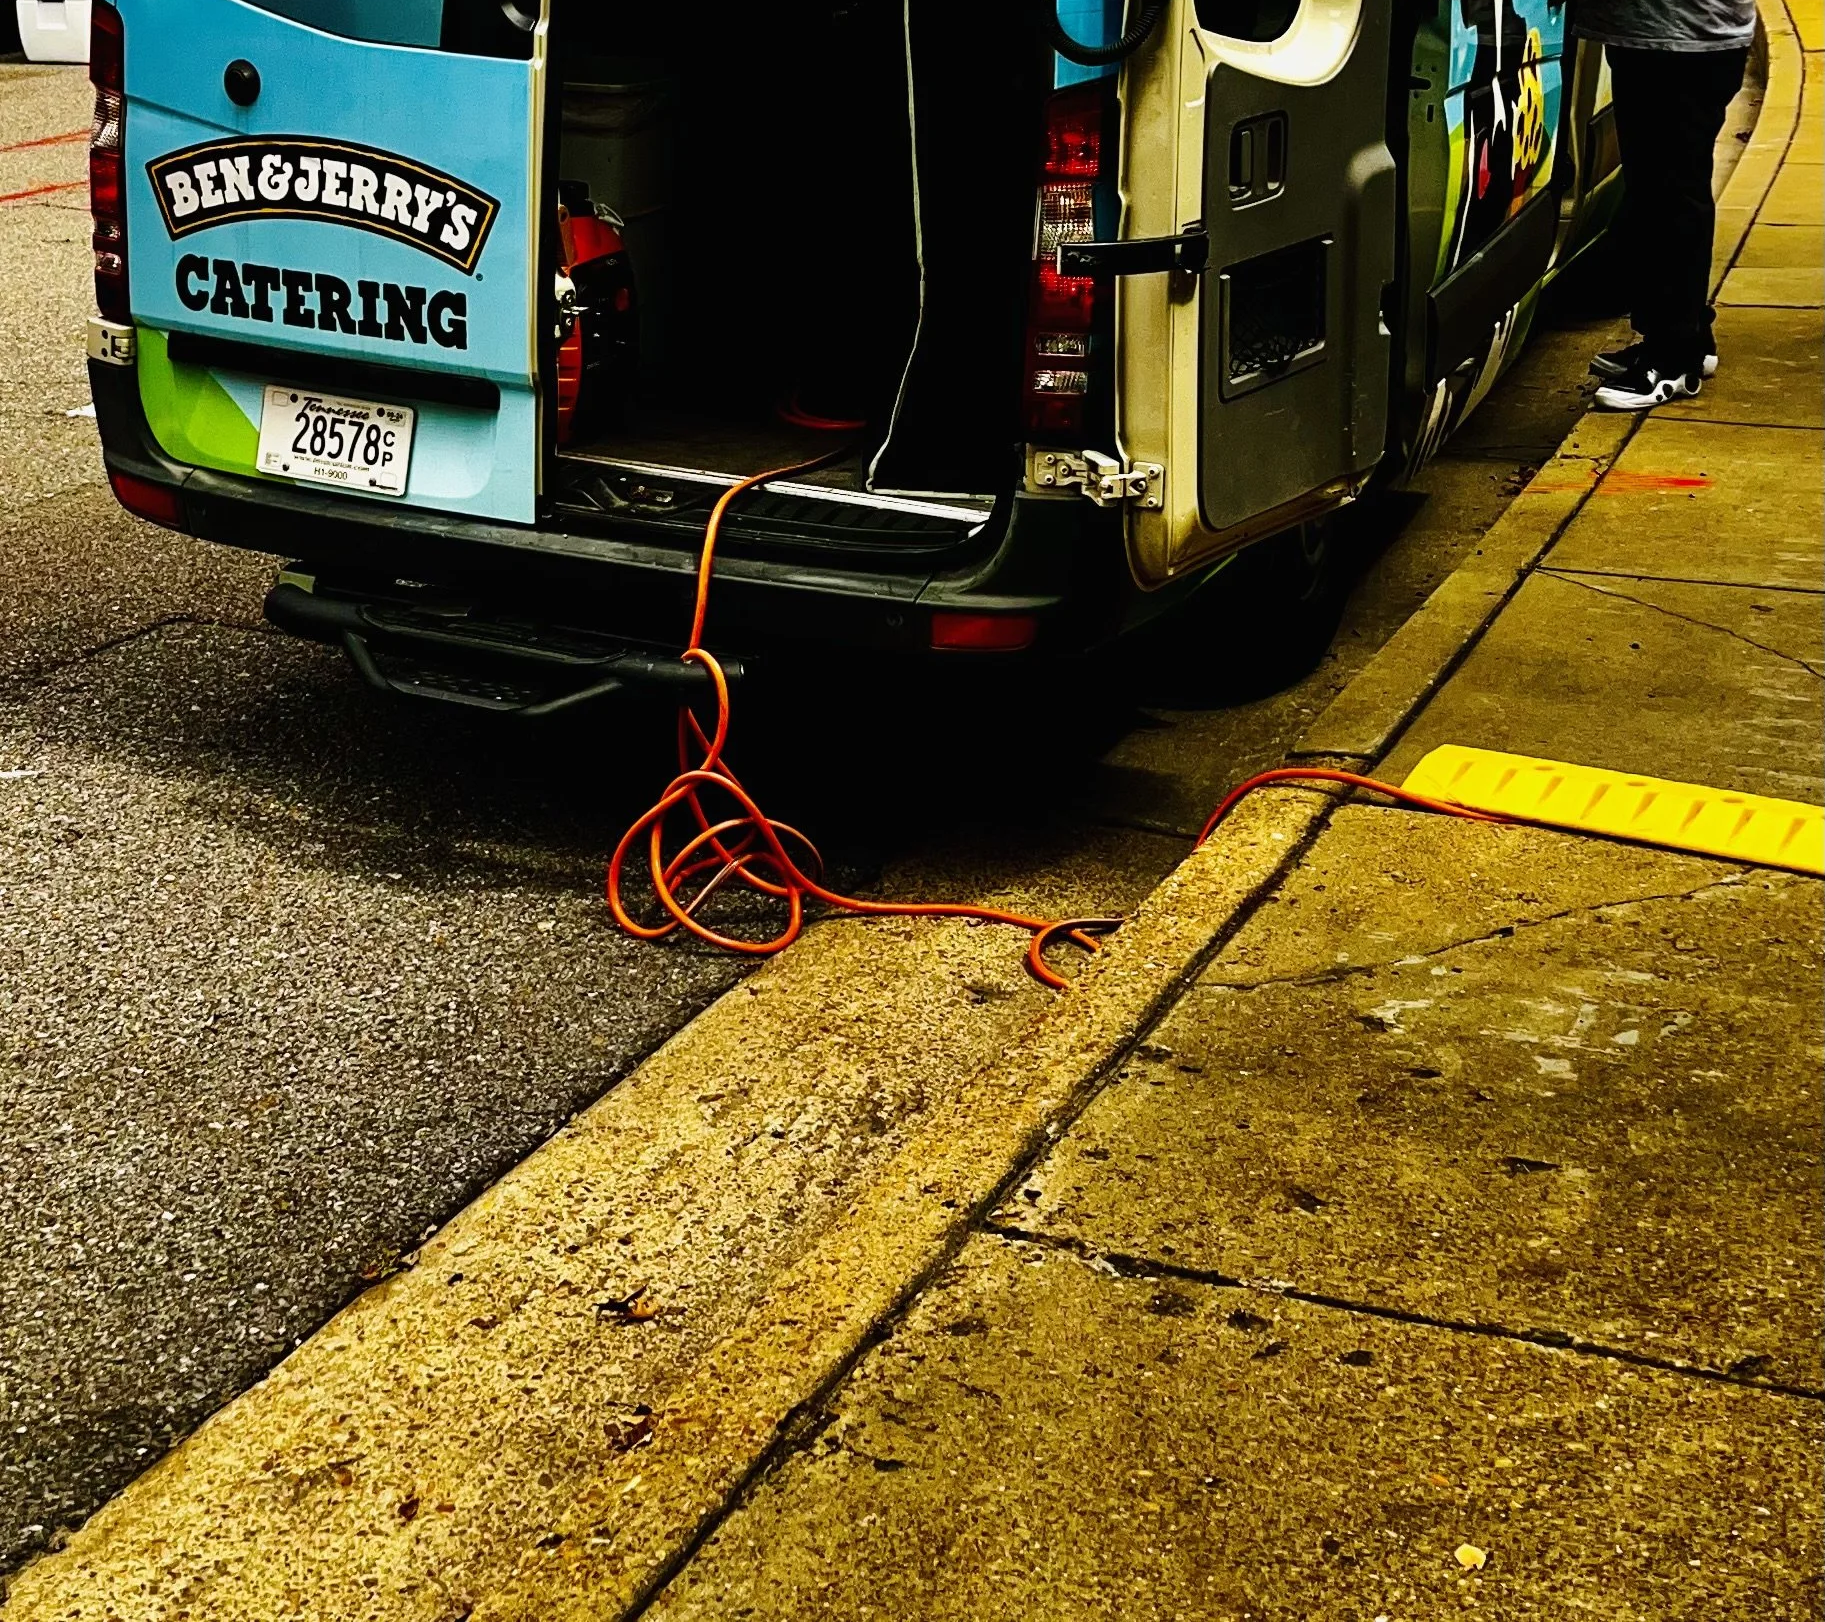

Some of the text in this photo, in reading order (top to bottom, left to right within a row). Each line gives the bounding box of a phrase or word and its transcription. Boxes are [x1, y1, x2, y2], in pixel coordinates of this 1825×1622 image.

[165, 154, 478, 251] BEN & JERRY'S
[175, 253, 468, 350] CATERING
[303, 396, 370, 420] Tennessee
[291, 412, 382, 466] 28578
[383, 430, 395, 447] C
[381, 451, 393, 467] P
